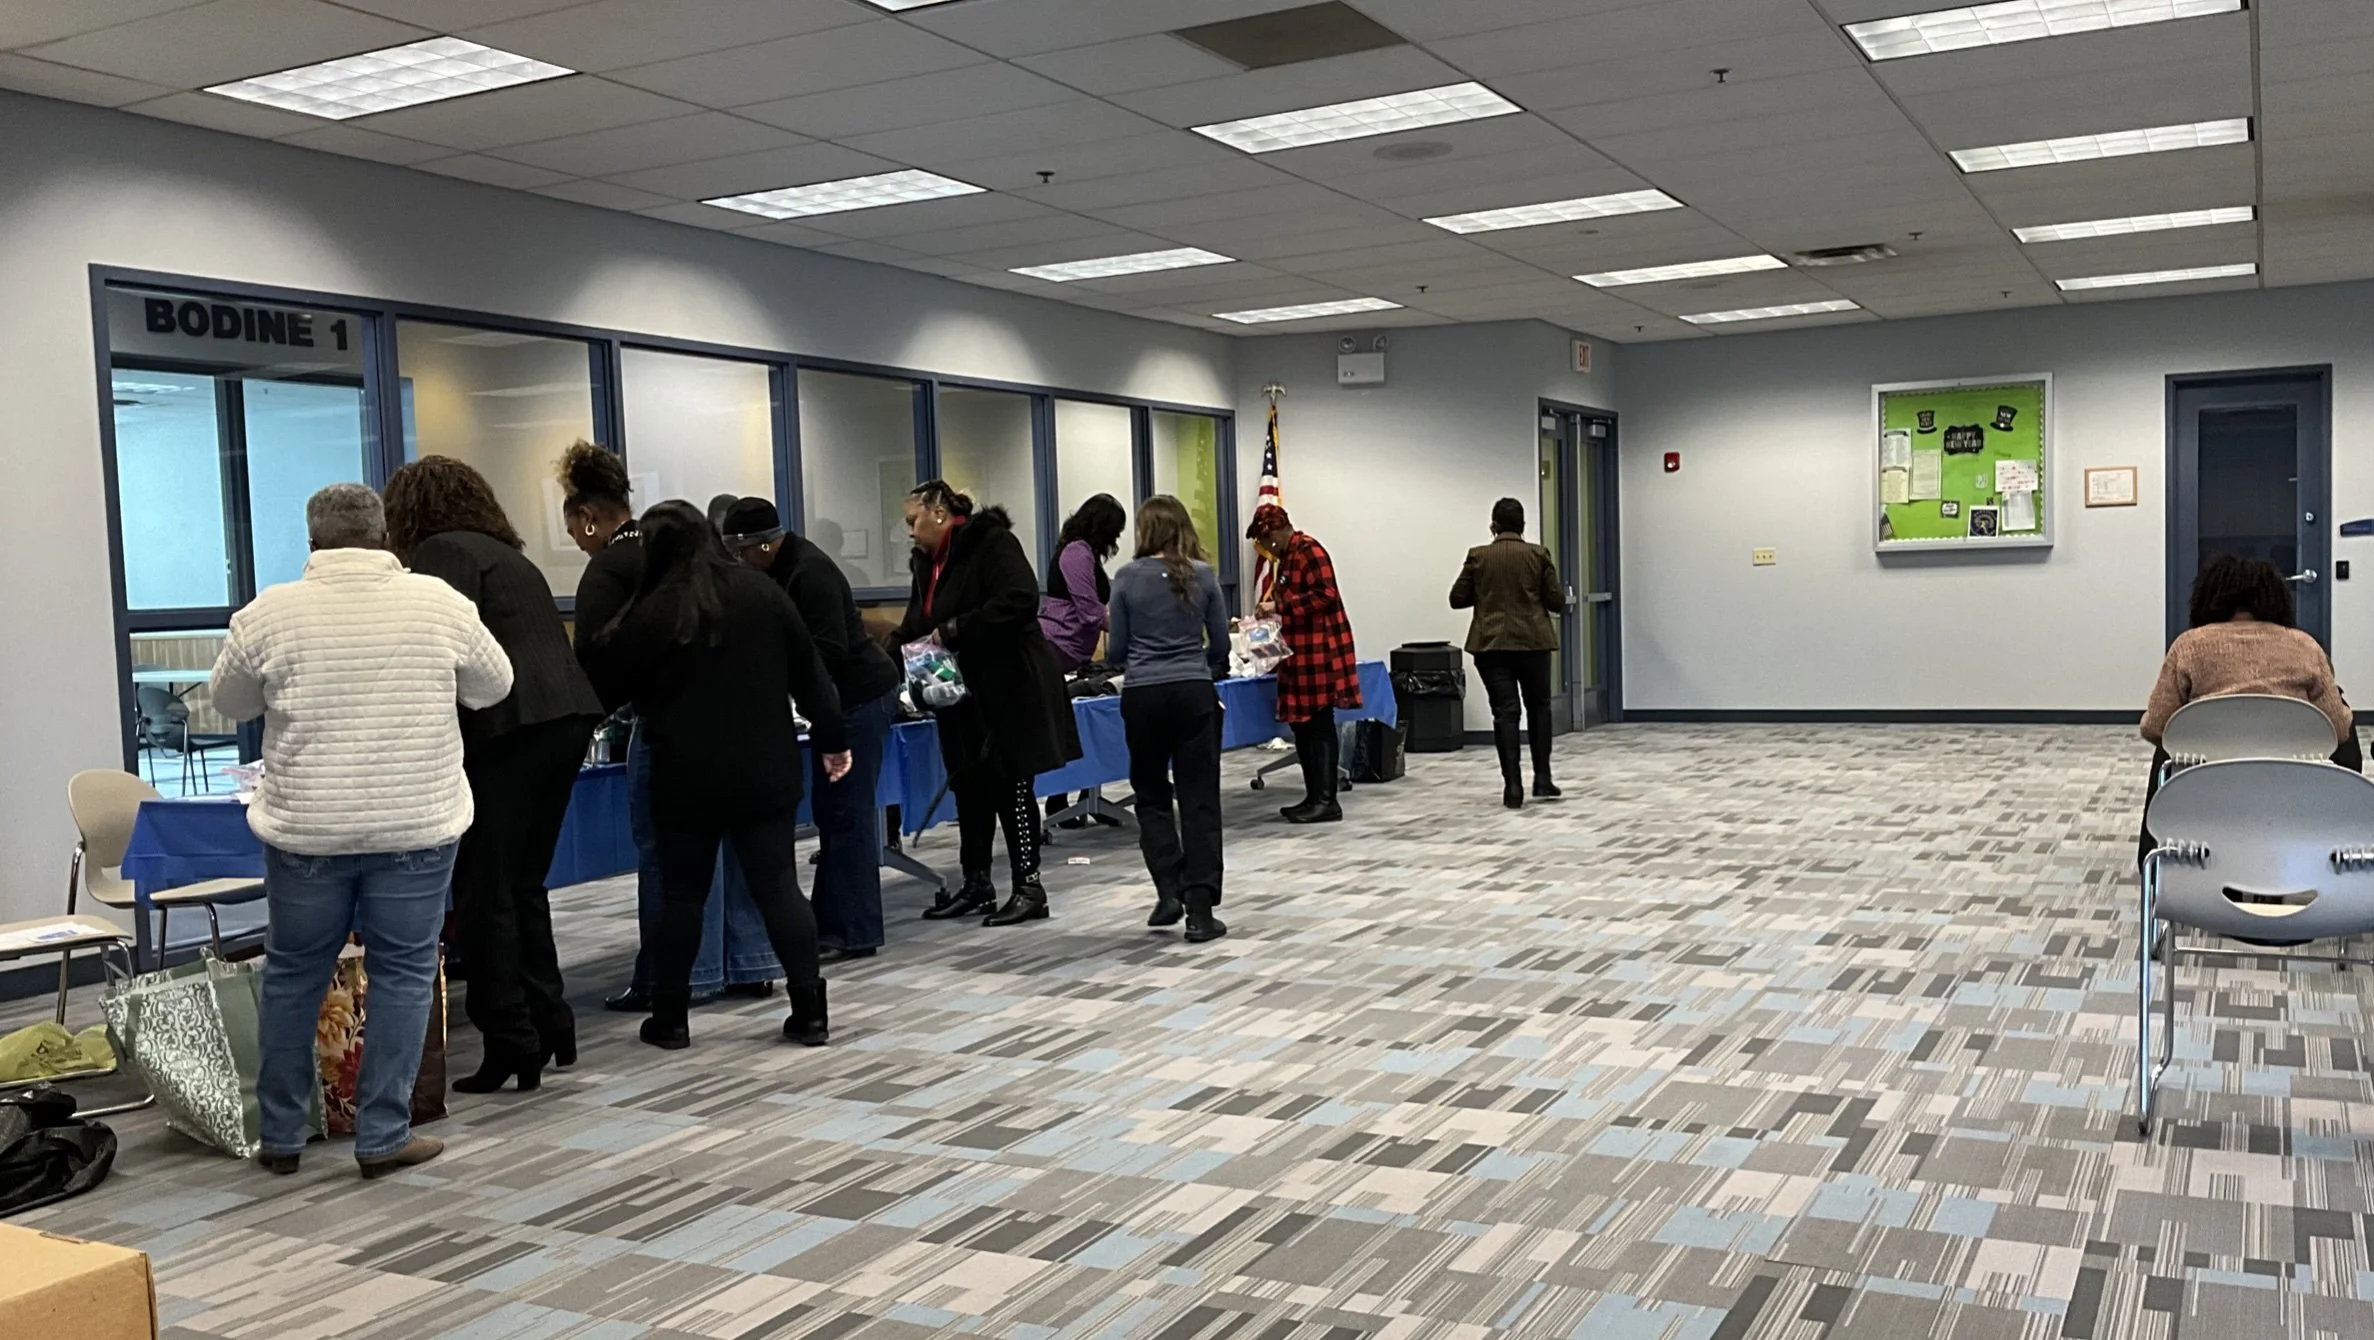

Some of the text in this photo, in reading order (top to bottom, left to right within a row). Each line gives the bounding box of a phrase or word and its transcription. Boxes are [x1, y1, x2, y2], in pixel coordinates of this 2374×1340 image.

[145, 298, 348, 351] BODINE 1
[1951, 431, 1976, 440] HAPPY
